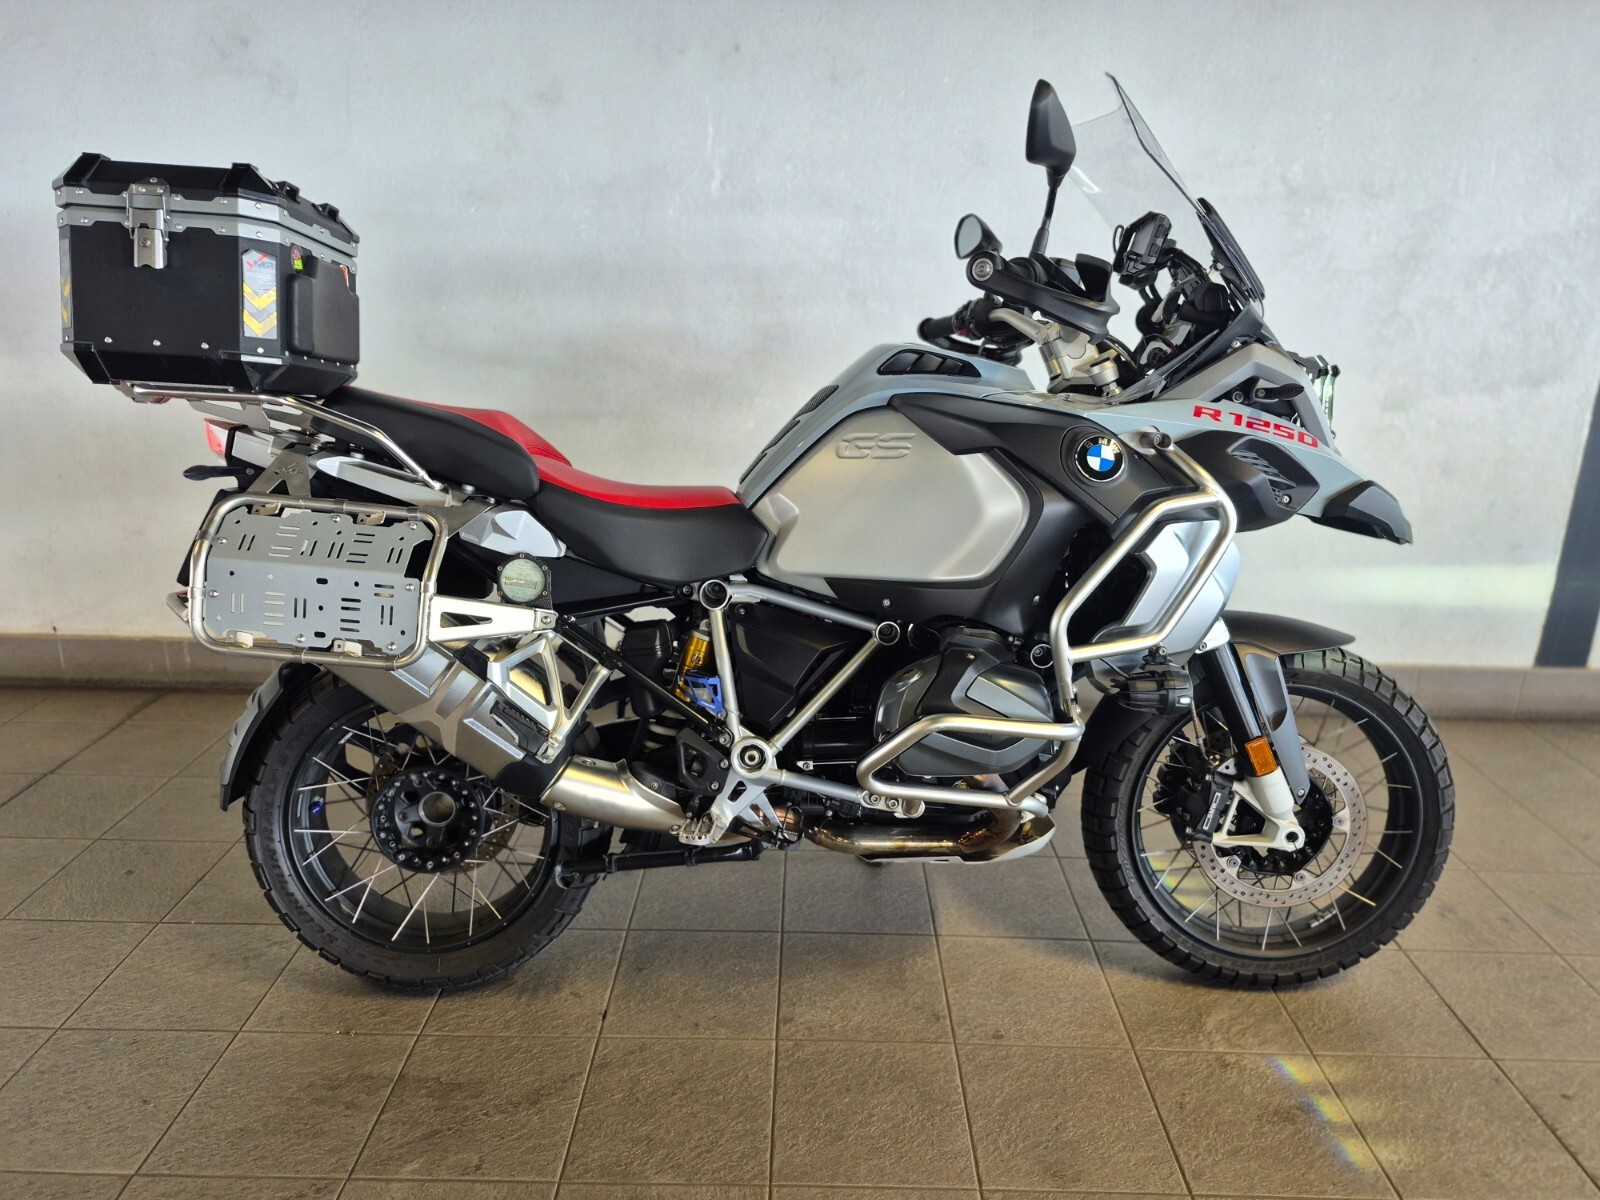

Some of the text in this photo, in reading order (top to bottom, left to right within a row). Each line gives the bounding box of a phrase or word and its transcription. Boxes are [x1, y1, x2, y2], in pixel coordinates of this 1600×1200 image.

[835, 432, 917, 459] GS
[1084, 437, 1120, 455] BMW
[1207, 803, 1217, 819] BMW
